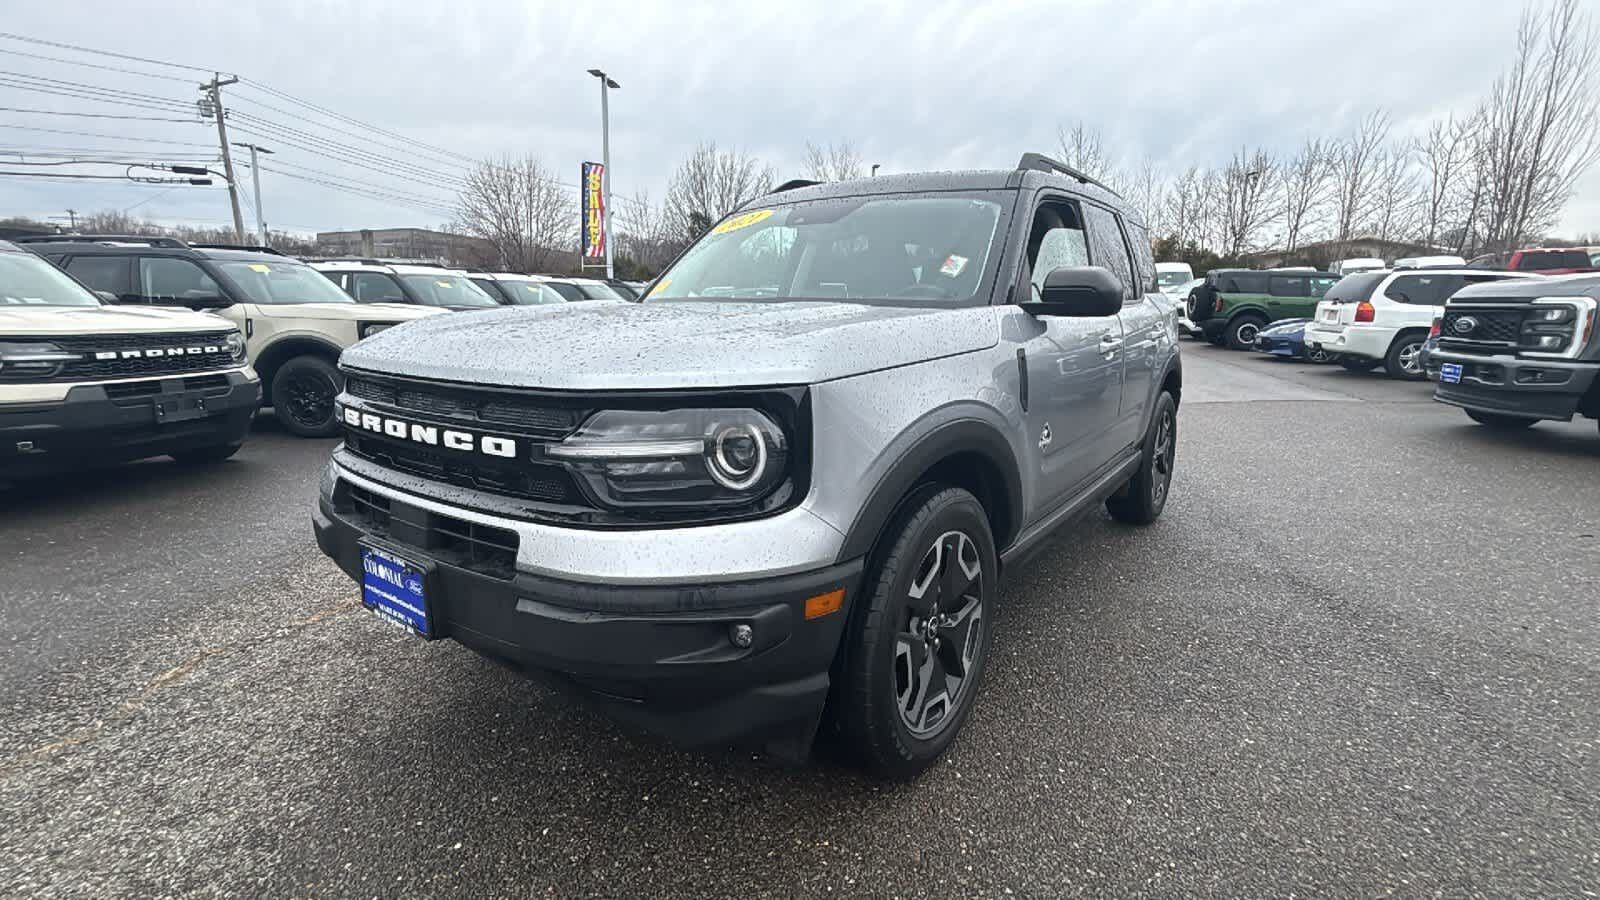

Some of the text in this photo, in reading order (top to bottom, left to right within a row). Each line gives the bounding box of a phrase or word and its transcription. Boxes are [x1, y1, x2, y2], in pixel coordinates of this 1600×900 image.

[589, 173, 601, 246] SALE
[95, 345, 218, 361] BRONCO
[344, 407, 517, 458] BRONCO
[363, 558, 405, 589] COLONIAL
